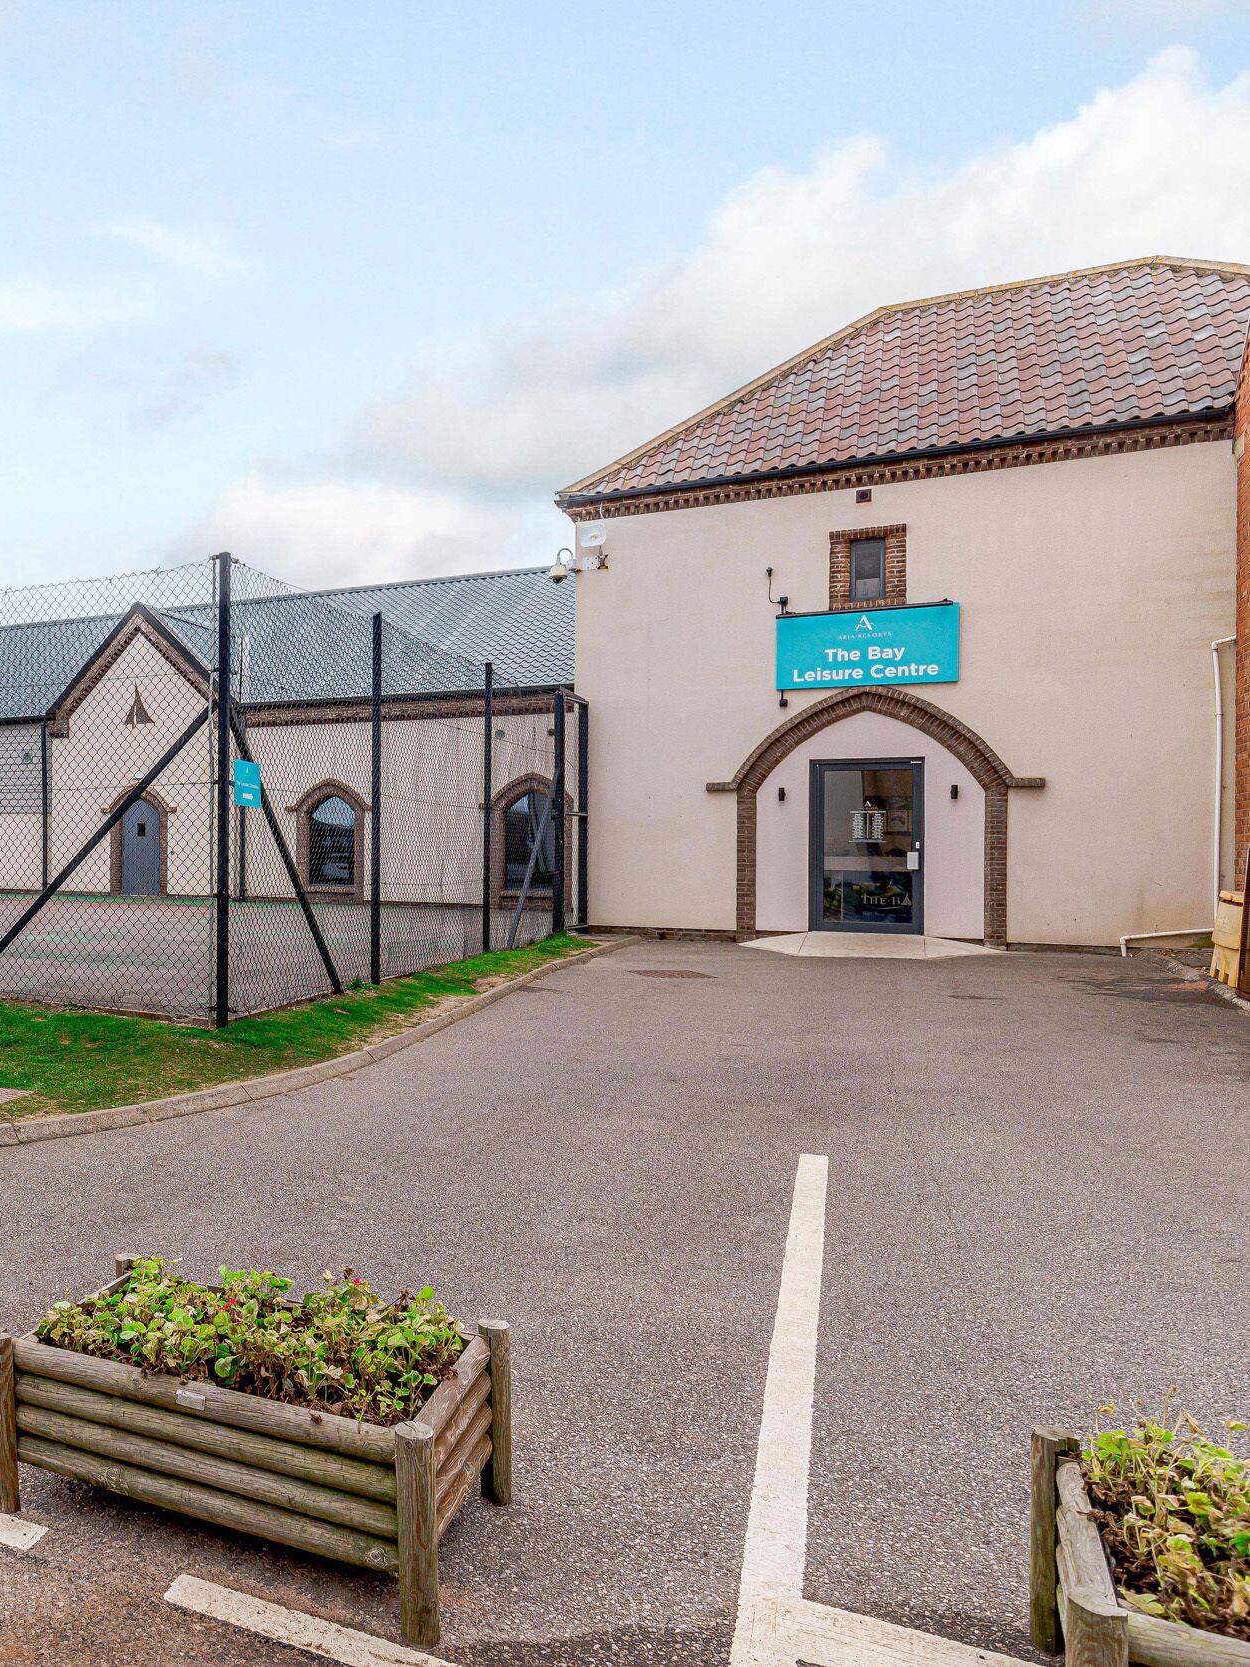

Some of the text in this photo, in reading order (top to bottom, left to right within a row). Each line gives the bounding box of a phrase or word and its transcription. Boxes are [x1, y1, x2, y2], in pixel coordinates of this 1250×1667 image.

[825, 646, 905, 663] The Bay
[793, 663, 939, 682] Leisure Centre
